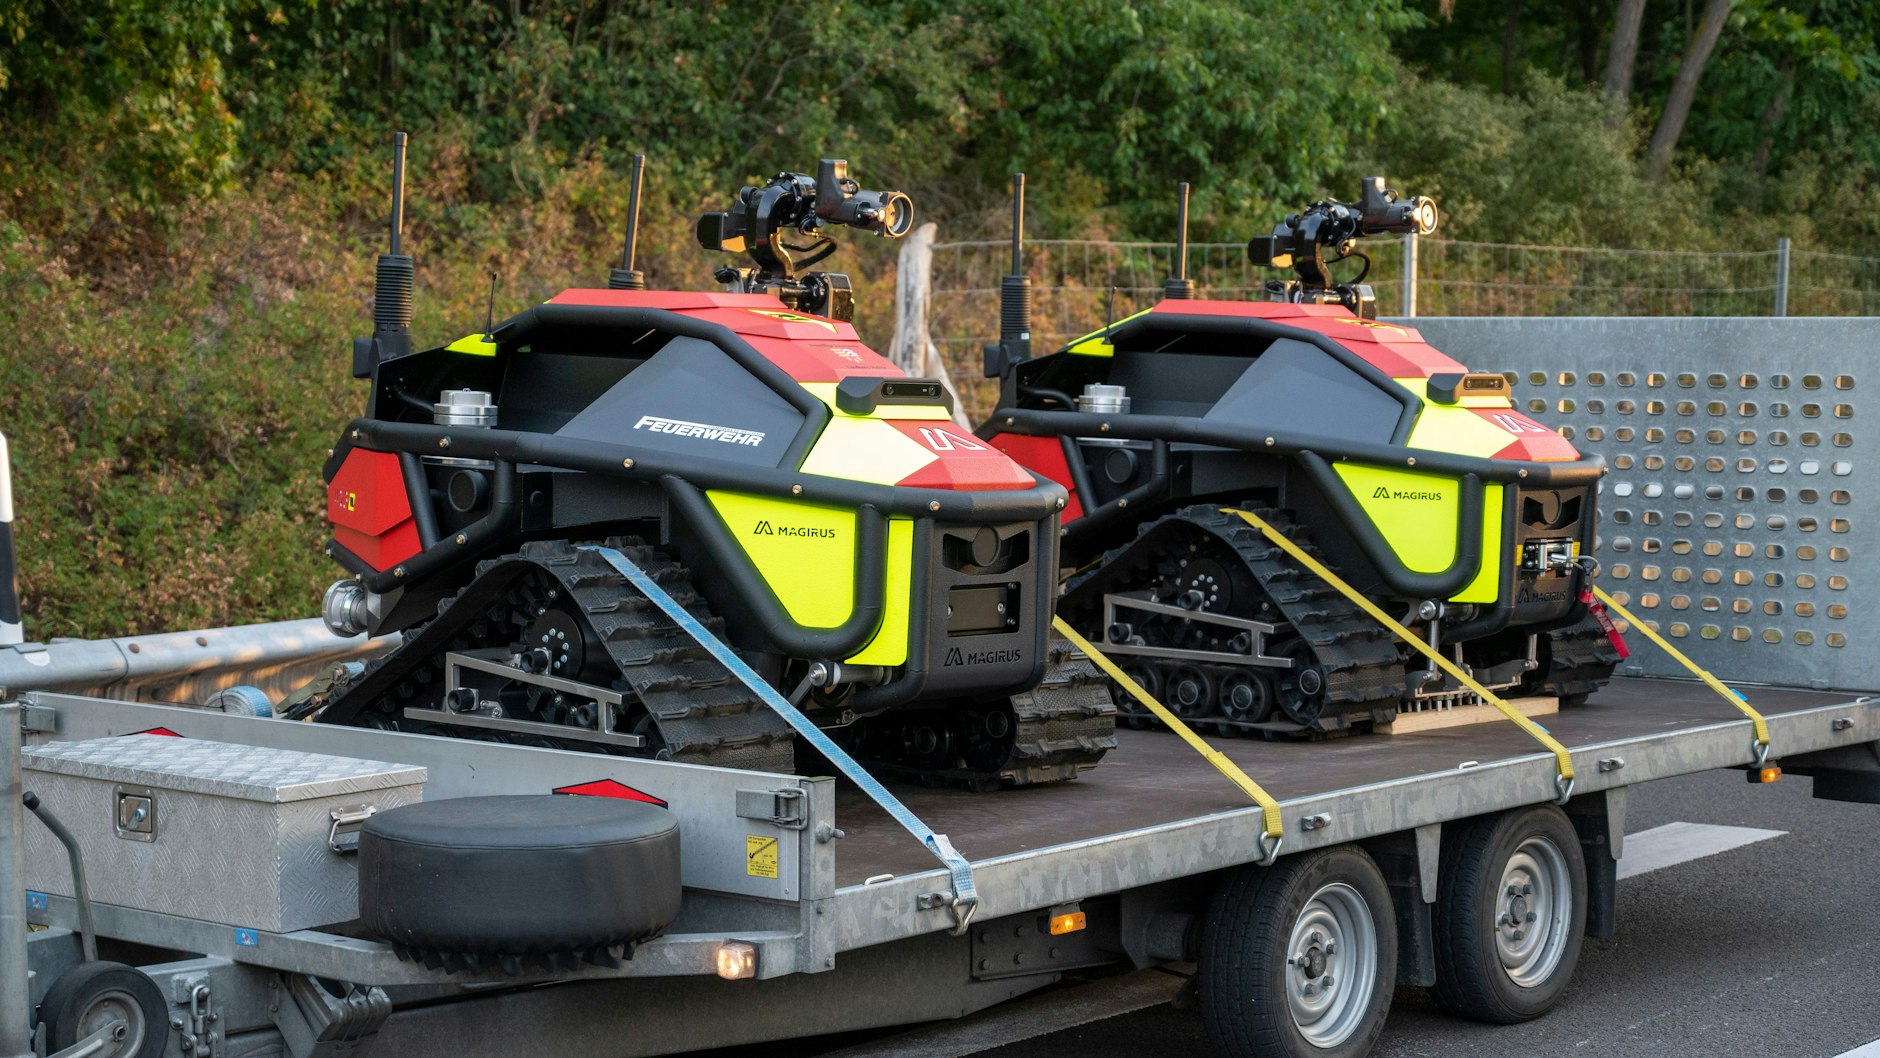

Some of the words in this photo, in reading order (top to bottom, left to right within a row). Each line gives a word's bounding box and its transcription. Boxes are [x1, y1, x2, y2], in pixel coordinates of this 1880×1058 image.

[633, 415, 763, 447] FEUERWEHR
[1393, 491, 1442, 501] MAGIRUS
[778, 526, 835, 539] MAGIRUS
[967, 649, 1021, 665] MAGIRUS
